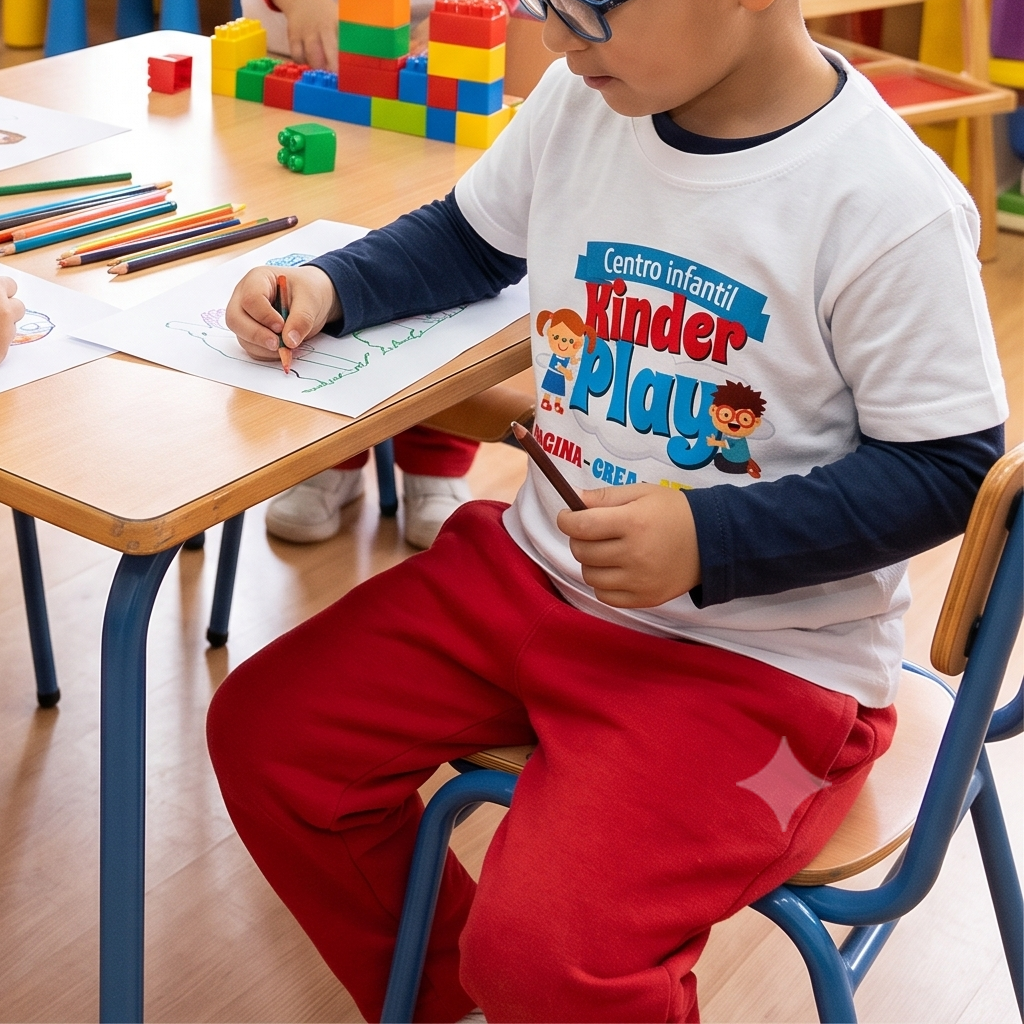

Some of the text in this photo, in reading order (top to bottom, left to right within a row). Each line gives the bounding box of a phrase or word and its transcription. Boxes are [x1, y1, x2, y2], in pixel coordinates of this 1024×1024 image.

[585, 278, 748, 365] Kinder
[604, 247, 739, 311] Centro infantil
[569, 336, 723, 471] Play
